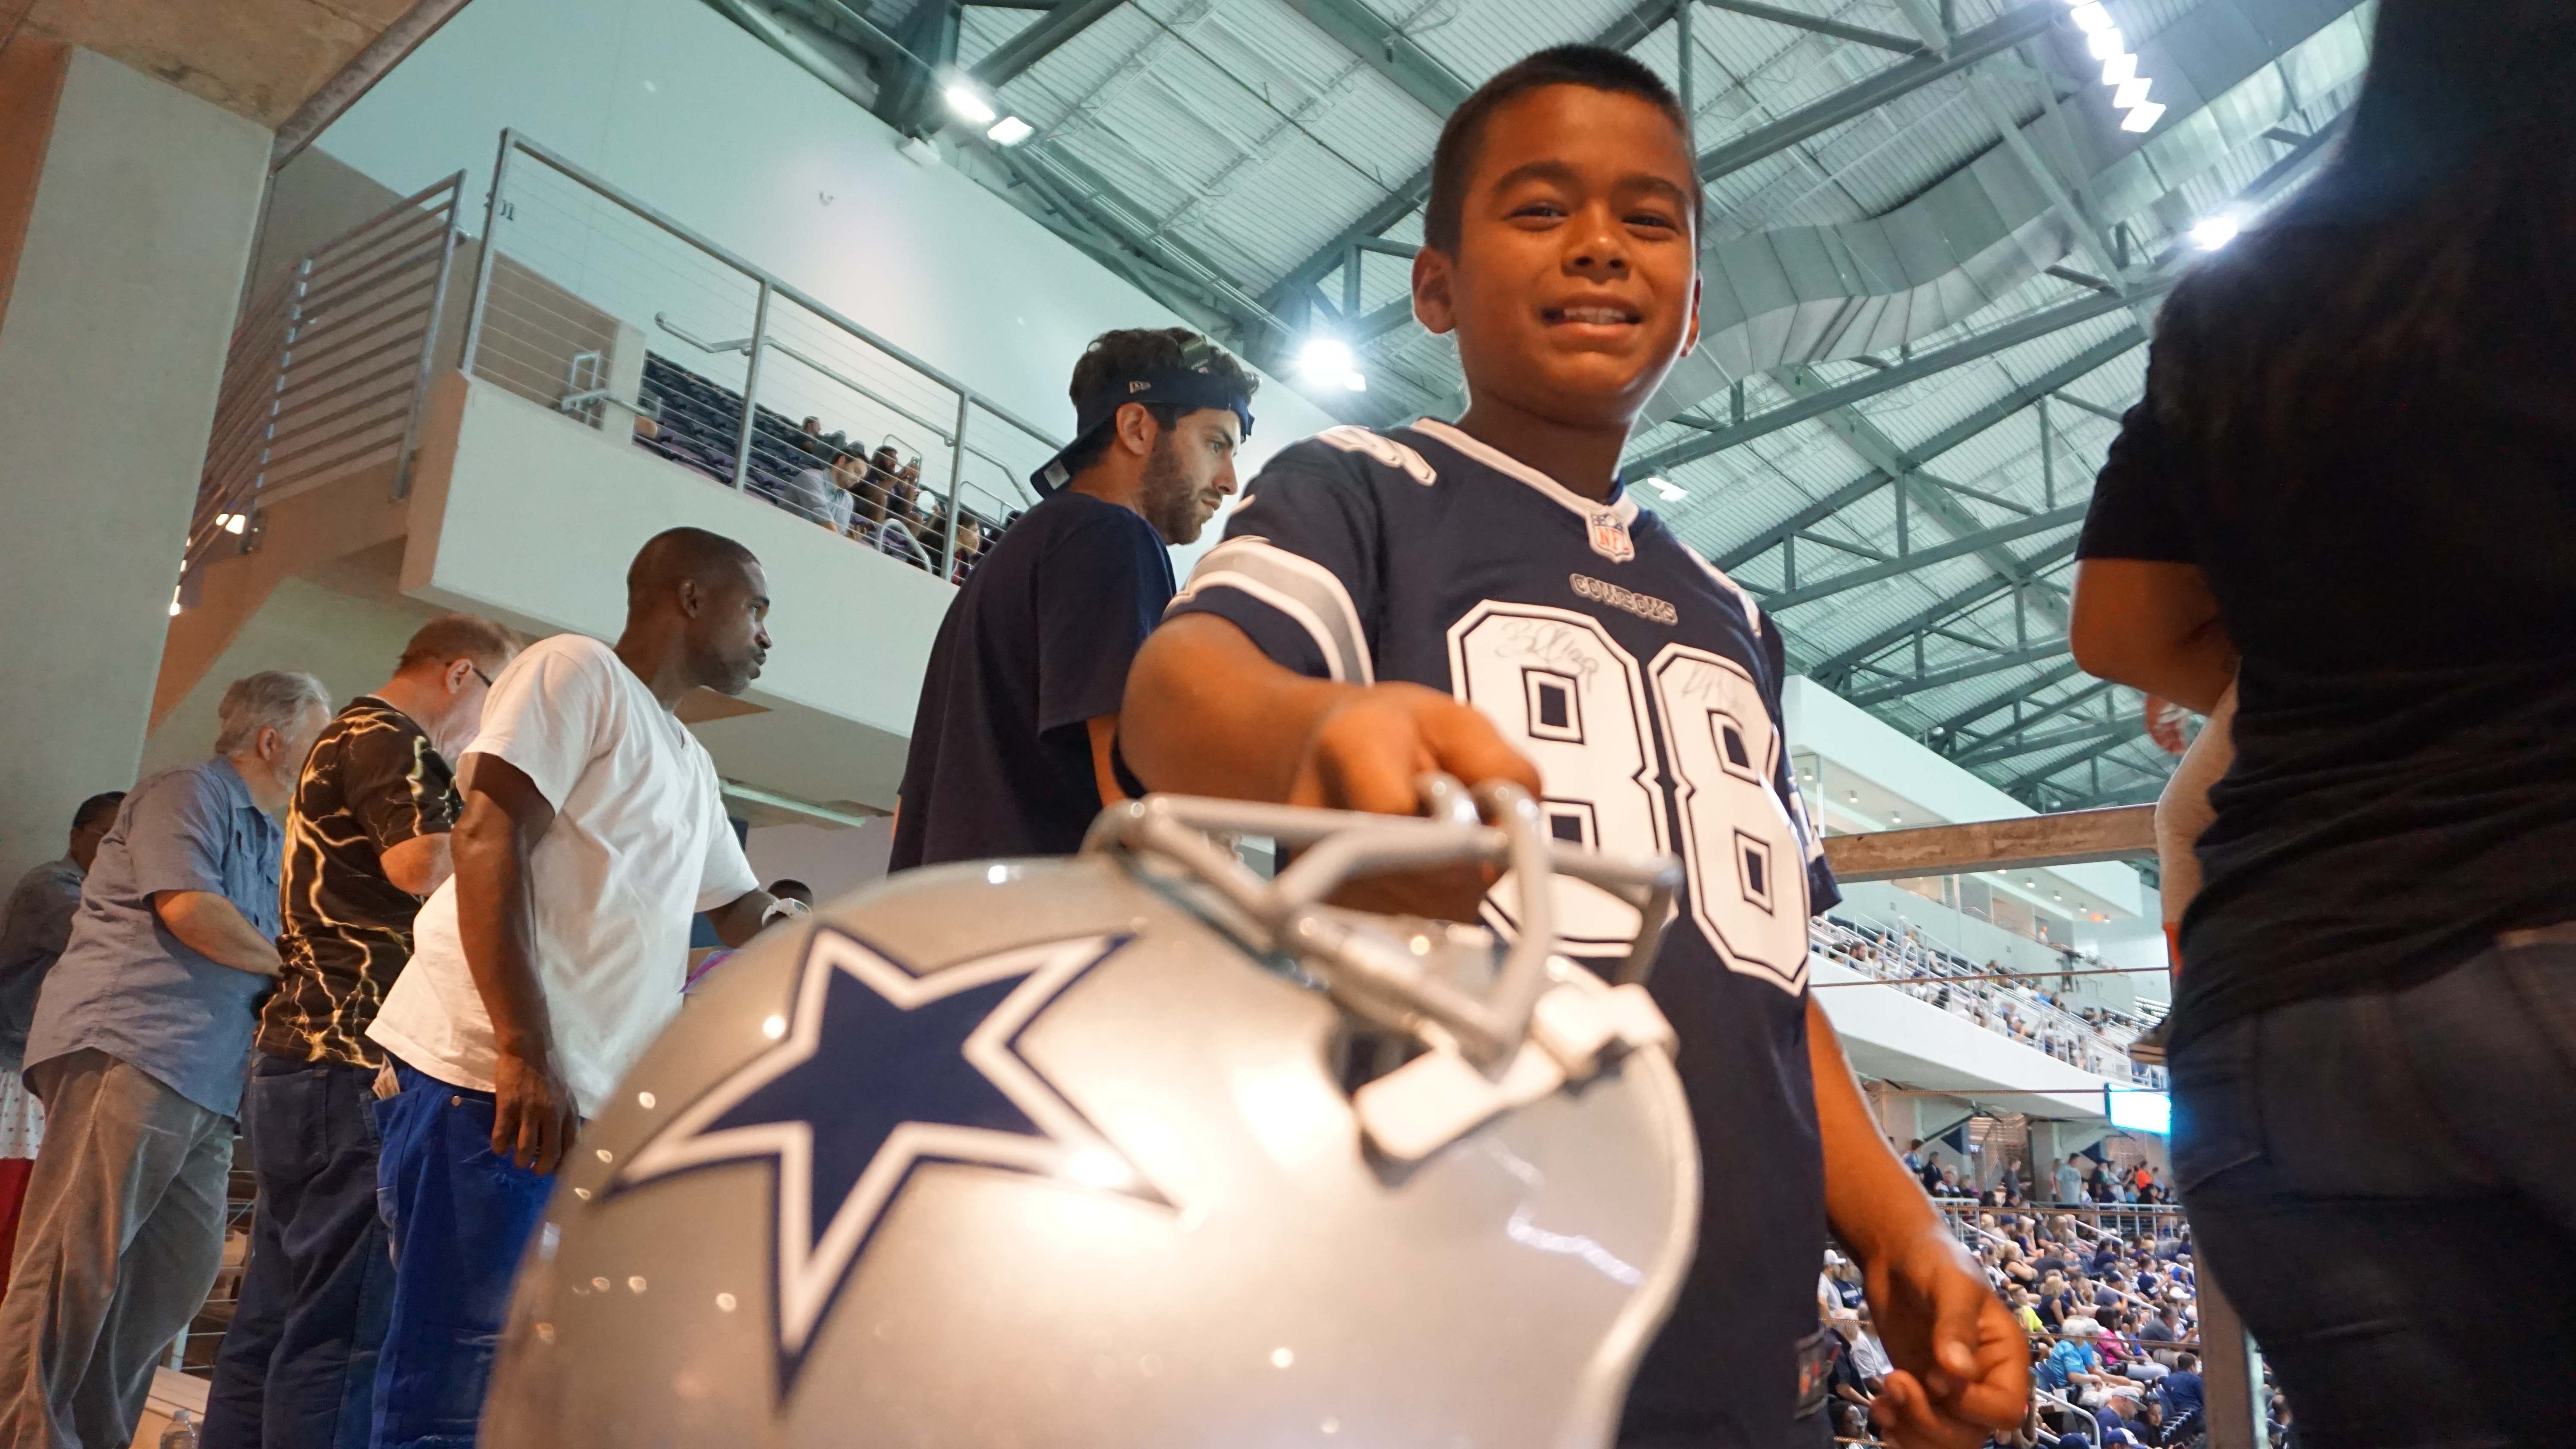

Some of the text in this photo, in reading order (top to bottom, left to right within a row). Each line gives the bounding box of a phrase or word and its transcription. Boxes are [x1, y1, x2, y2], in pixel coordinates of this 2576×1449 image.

[1596, 527, 1630, 550] NFL
[1569, 573, 1678, 626] COWBOYS
[1447, 599, 1810, 997] 88
